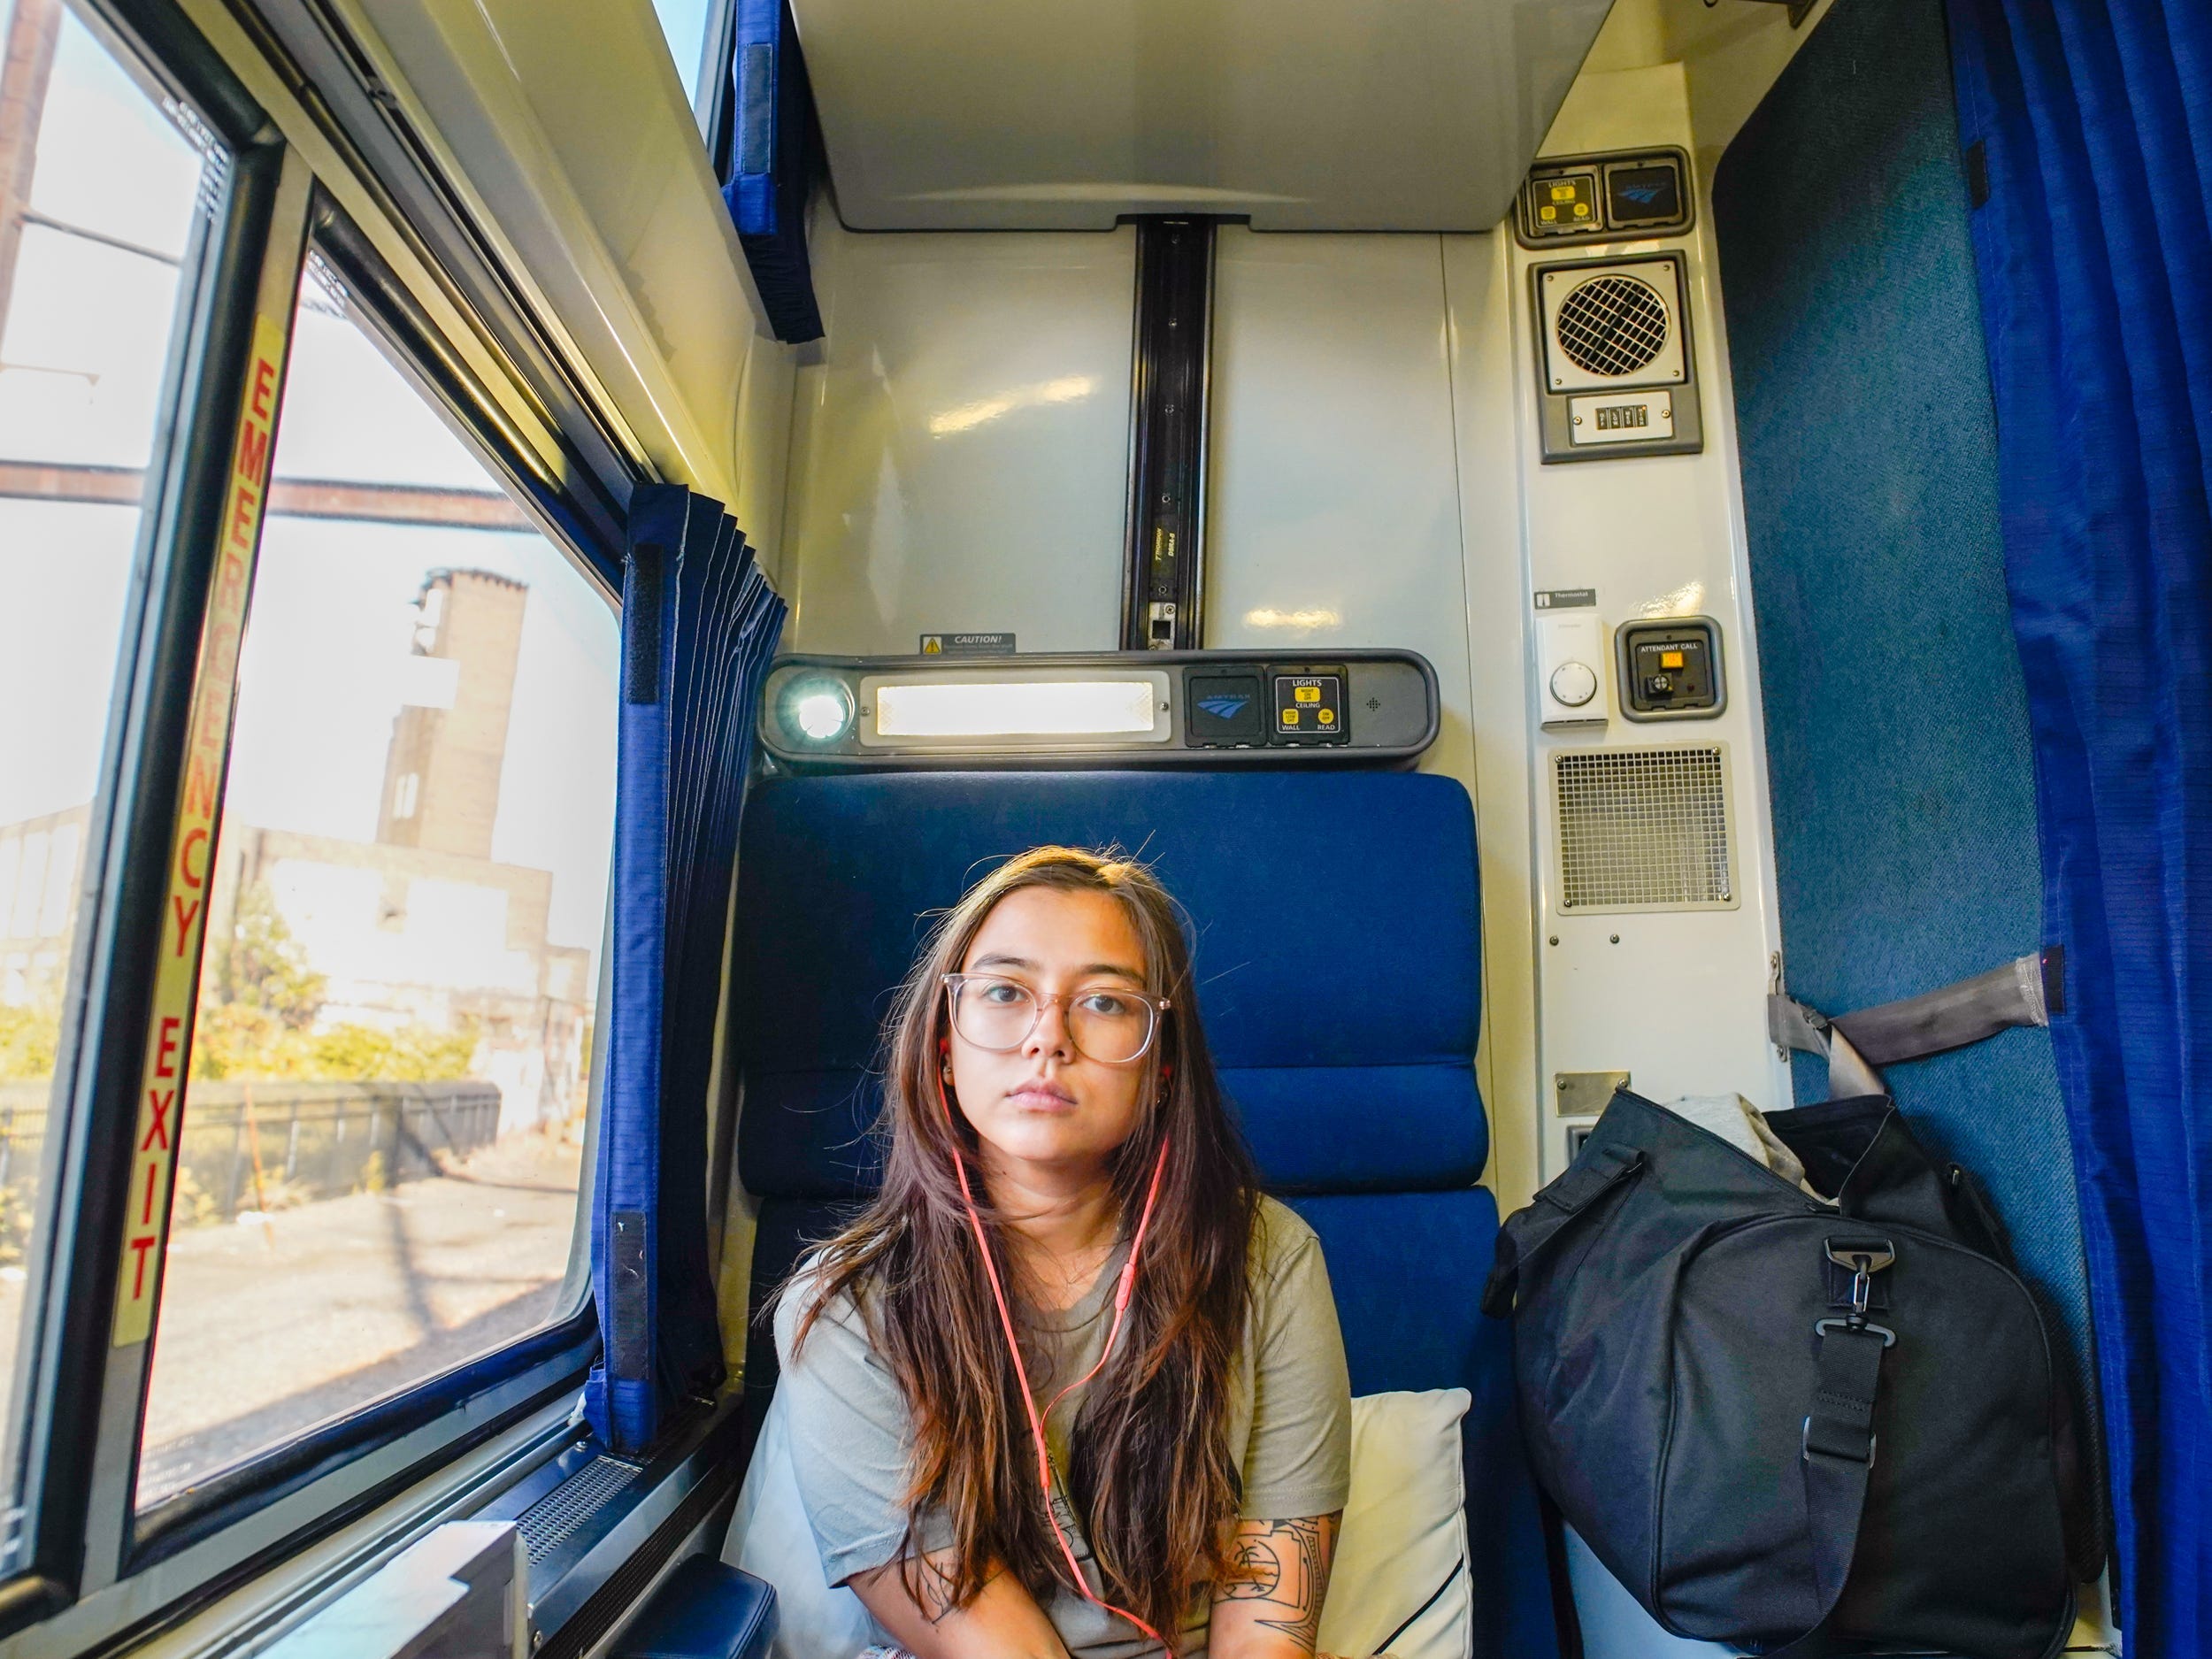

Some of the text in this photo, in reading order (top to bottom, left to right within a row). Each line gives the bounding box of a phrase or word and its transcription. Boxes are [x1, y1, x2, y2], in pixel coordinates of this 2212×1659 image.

[955, 635, 1002, 644] CAUTION!
[1641, 644, 1678, 653] ATTENDANT
[130, 358, 274, 1300] EMERGENCY EXIT
